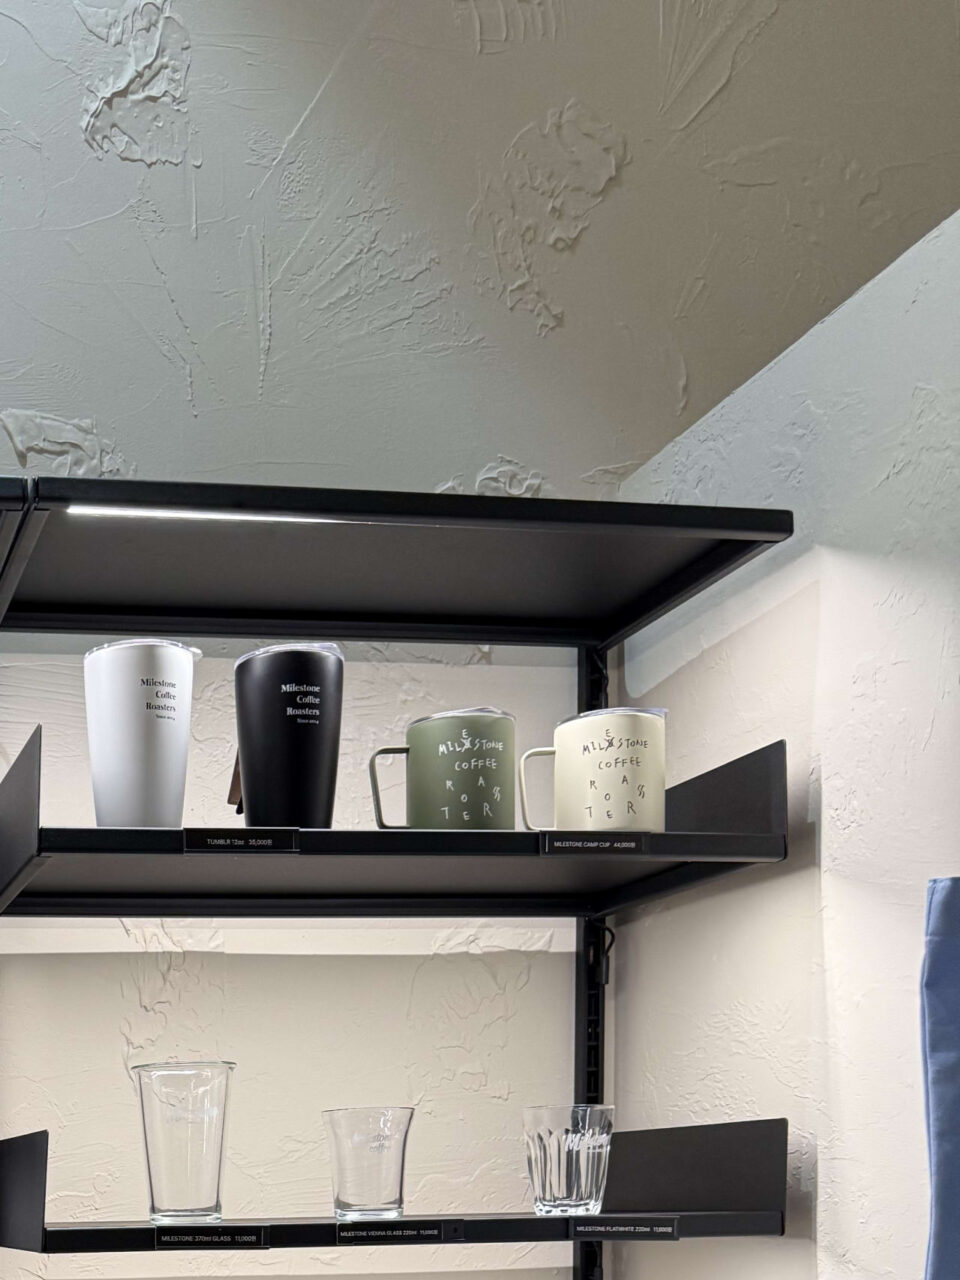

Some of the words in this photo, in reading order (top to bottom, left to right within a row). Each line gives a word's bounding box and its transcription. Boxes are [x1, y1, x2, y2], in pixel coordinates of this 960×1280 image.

[140, 678, 176, 688] Milestone
[281, 683, 320, 692] Milestone
[155, 690, 176, 700] Coffee
[296, 695, 320, 704] Coffee
[145, 702, 176, 712] Roasters
[287, 707, 320, 716] Roasters
[455, 758, 497, 771] COFFEE
[598, 757, 642, 770] COFFEE
